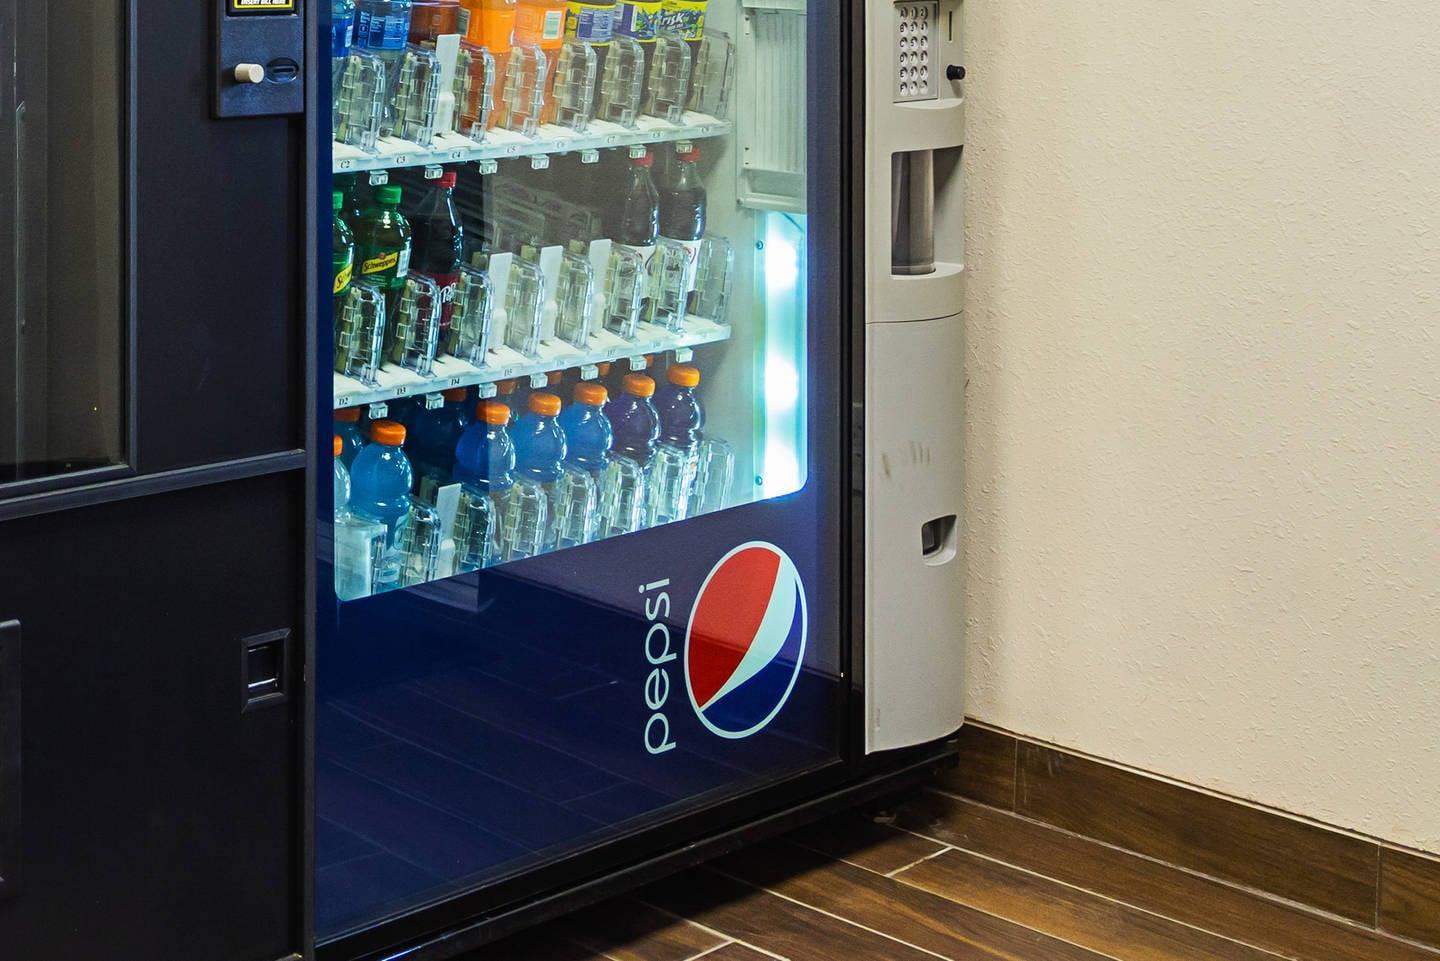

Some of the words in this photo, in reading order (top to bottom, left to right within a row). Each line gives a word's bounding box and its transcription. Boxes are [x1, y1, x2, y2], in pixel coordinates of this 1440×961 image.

[451, 150, 461, 159] C4
[339, 160, 351, 169] C2
[395, 156, 406, 165] C3
[363, 255, 397, 270] Schweppes
[450, 377, 460, 386] D4
[396, 387, 406, 395] D3
[338, 397, 349, 406] D2
[638, 578, 677, 756] pepsi
